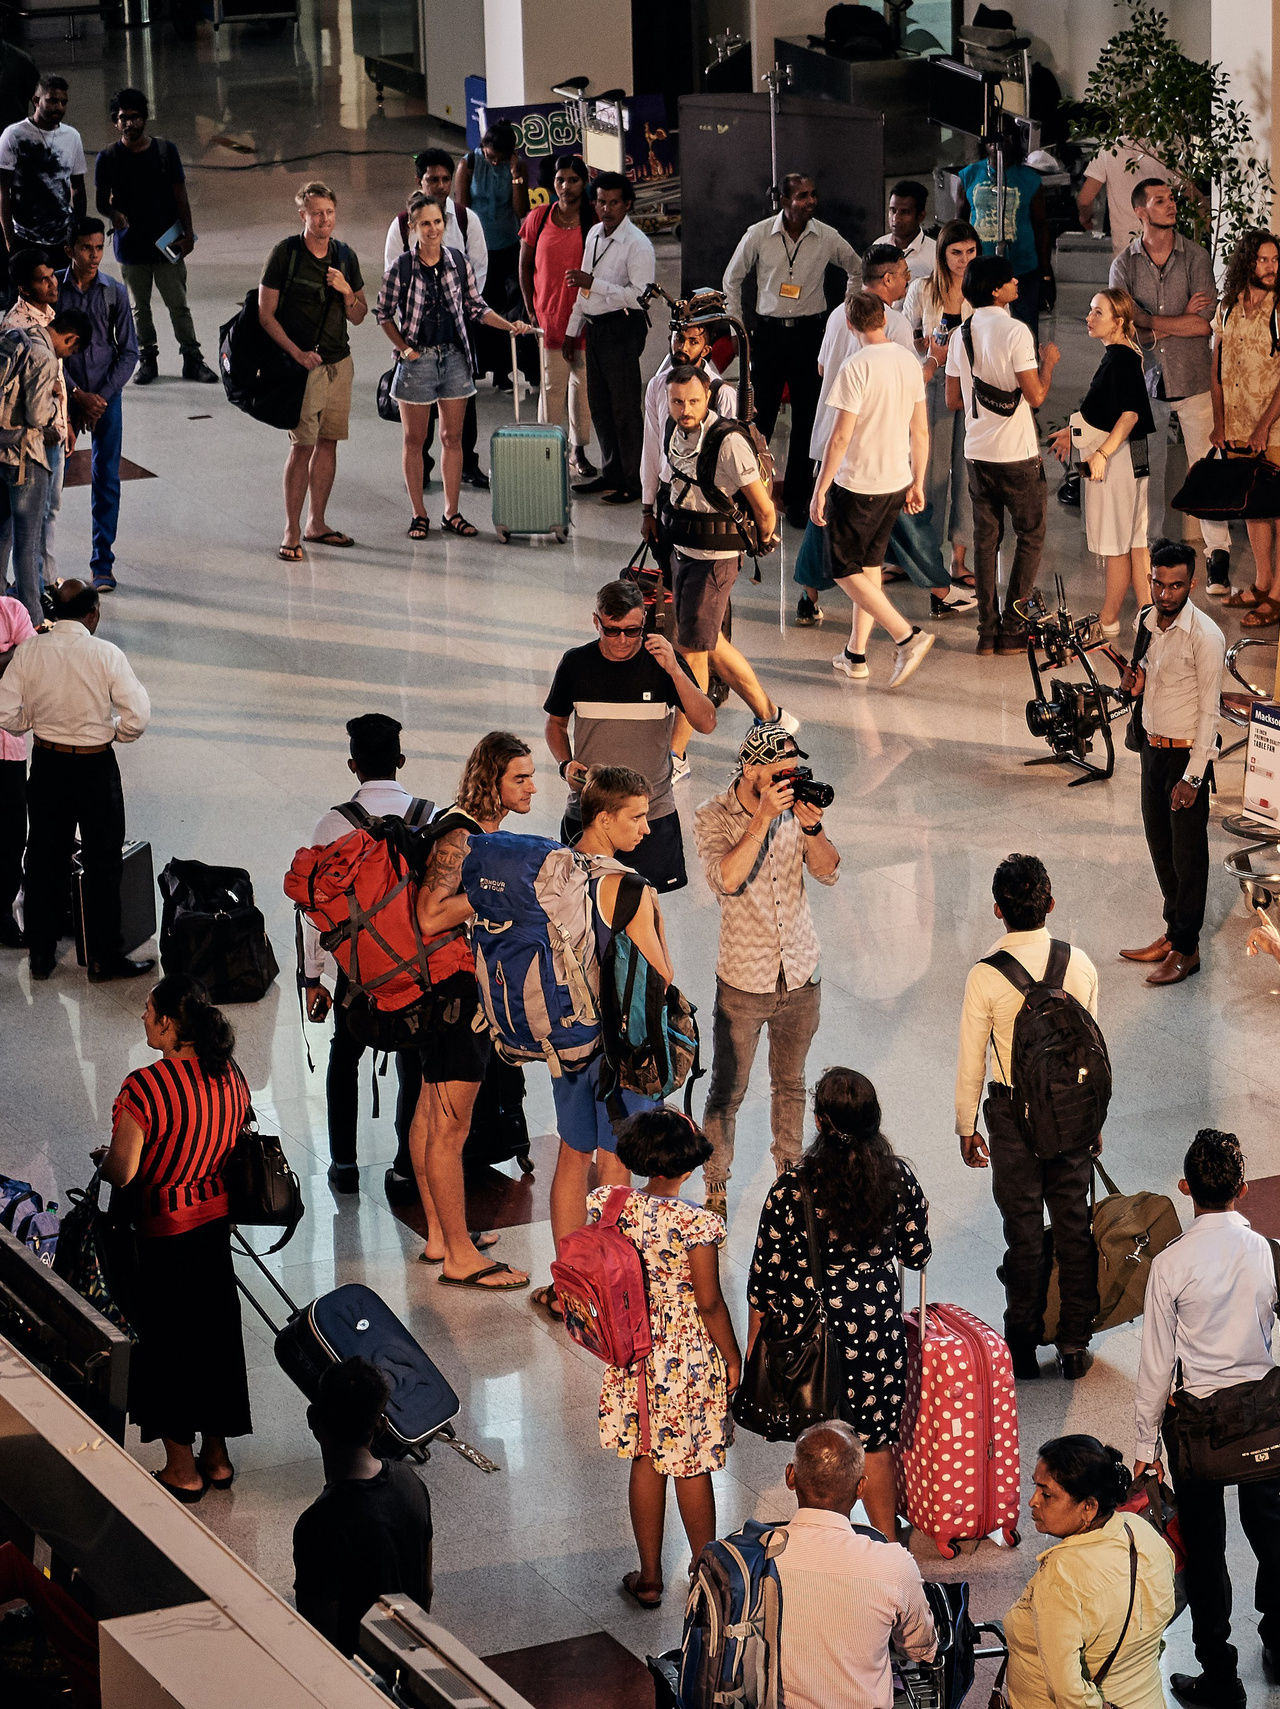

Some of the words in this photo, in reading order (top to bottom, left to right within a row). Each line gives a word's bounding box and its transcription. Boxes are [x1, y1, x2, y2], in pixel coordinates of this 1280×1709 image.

[1110, 707, 1129, 719] RONIN
[1253, 740, 1267, 750] TABLE
[1267, 744, 1275, 753] FAN
